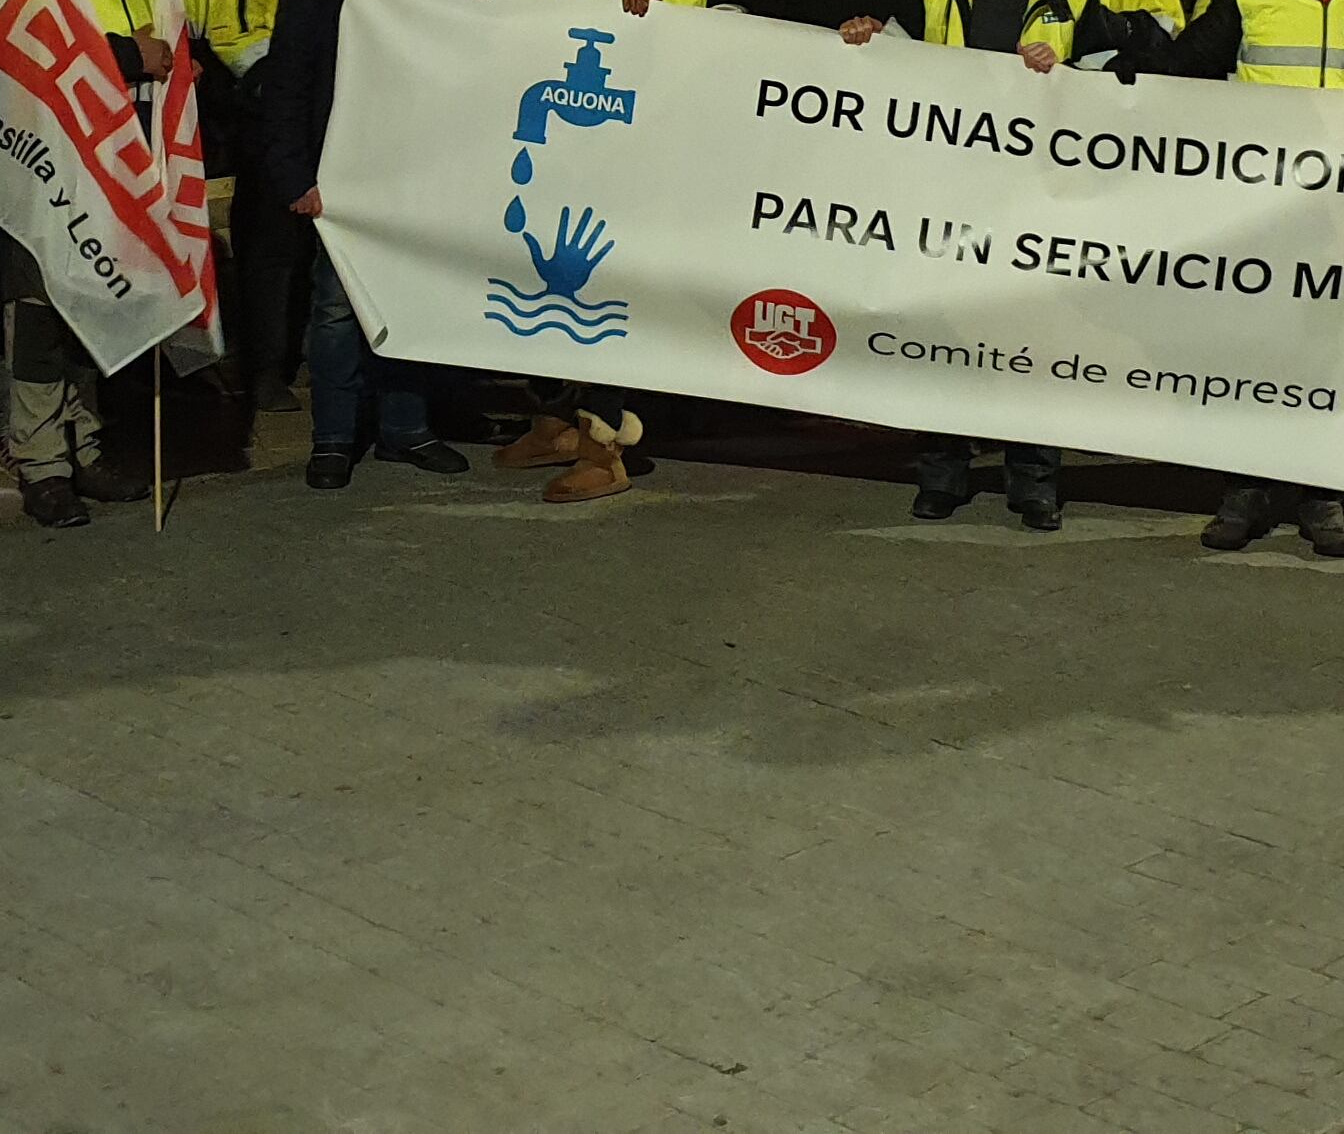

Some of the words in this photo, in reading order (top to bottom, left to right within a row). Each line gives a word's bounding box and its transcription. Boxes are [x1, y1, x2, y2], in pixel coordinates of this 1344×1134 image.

[540, 85, 626, 114] AQUONA
[756, 79, 865, 132] POR
[886, 97, 1034, 157] UNAS
[50, 187, 71, 208] y
[66, 213, 133, 300] León
[751, 191, 896, 252] PARA
[919, 217, 992, 265] UN
[1011, 232, 1272, 295] SERVICIO
[754, 300, 818, 338] UGT
[867, 331, 1033, 375] Comité
[1050, 354, 1108, 384] de
[1126, 367, 1337, 413] empresa
